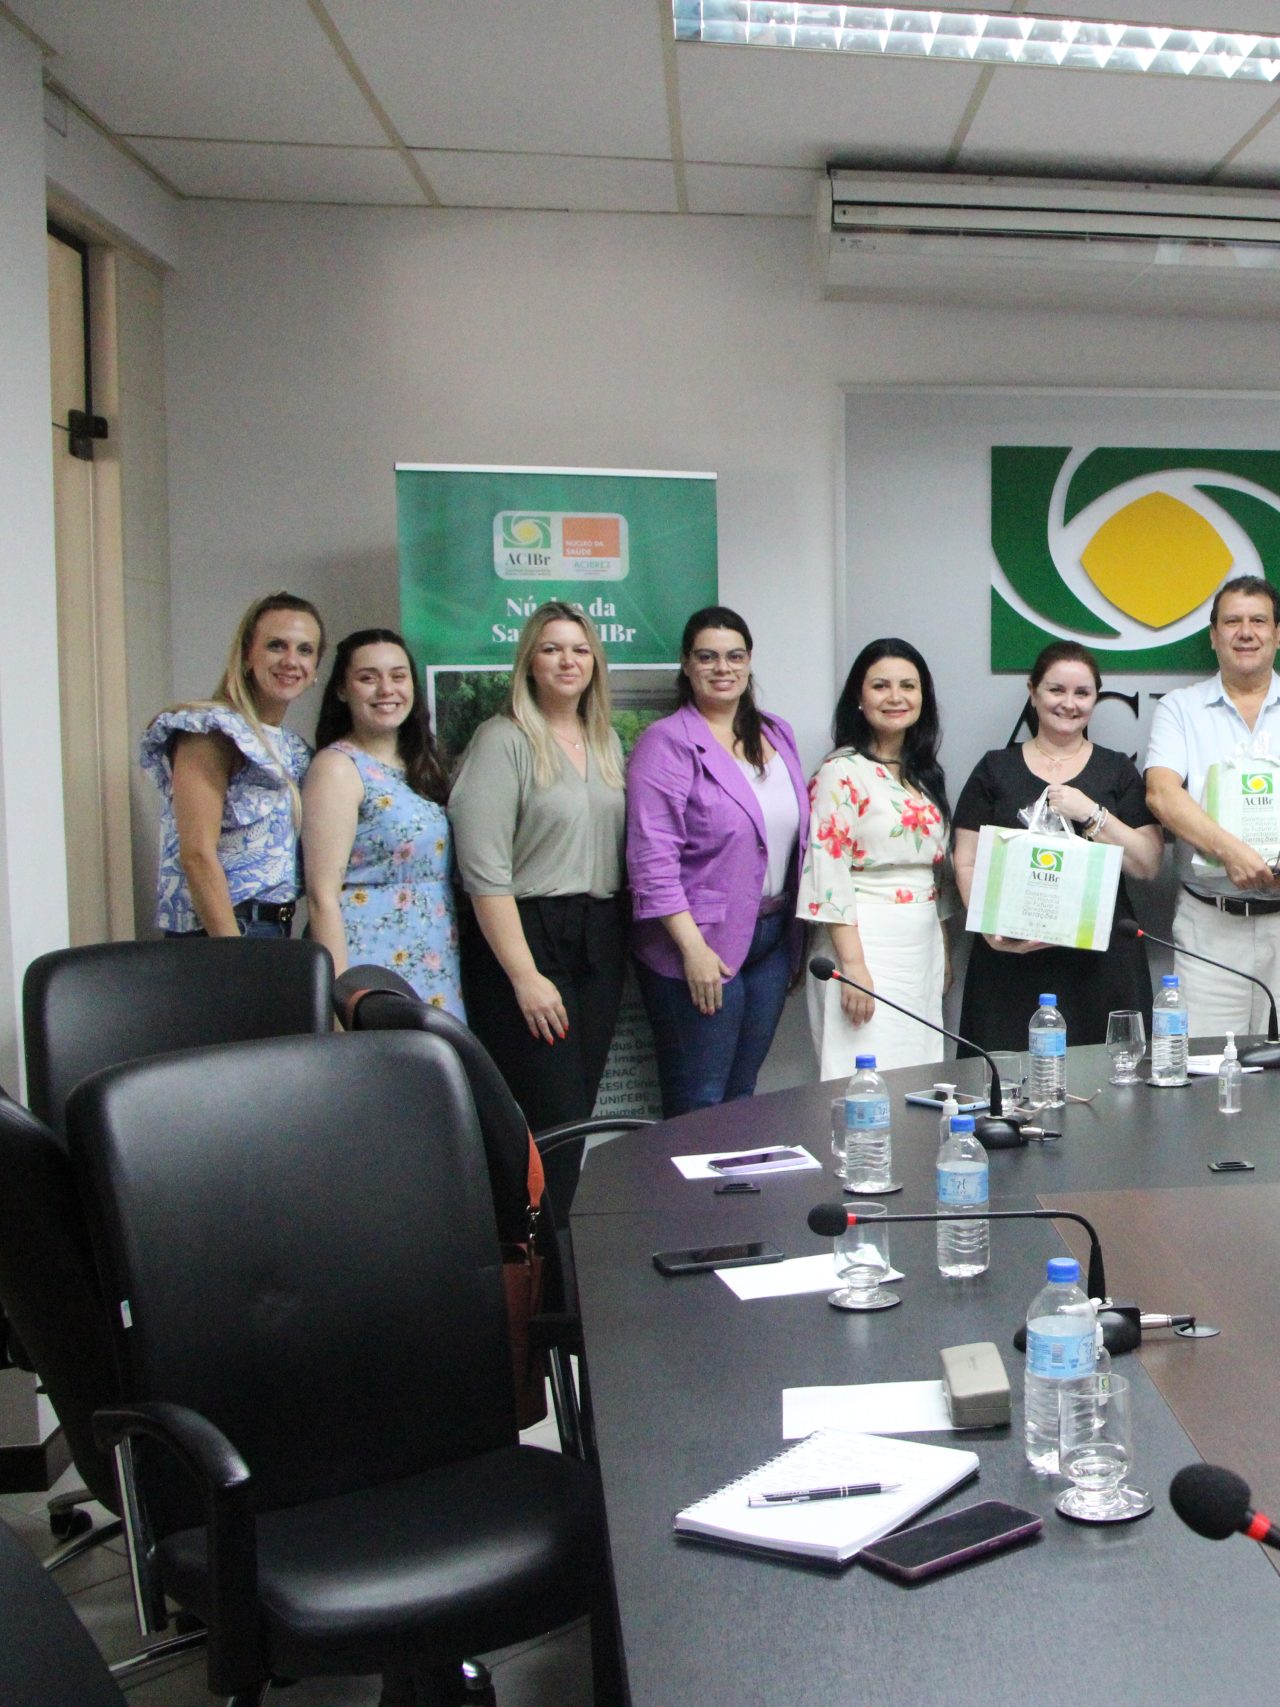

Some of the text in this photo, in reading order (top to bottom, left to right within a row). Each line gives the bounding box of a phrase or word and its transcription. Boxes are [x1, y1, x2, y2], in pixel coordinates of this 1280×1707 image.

[504, 553, 551, 566] ACIBr
[588, 597, 616, 617] da
[1028, 870, 1061, 883] ACIBr
